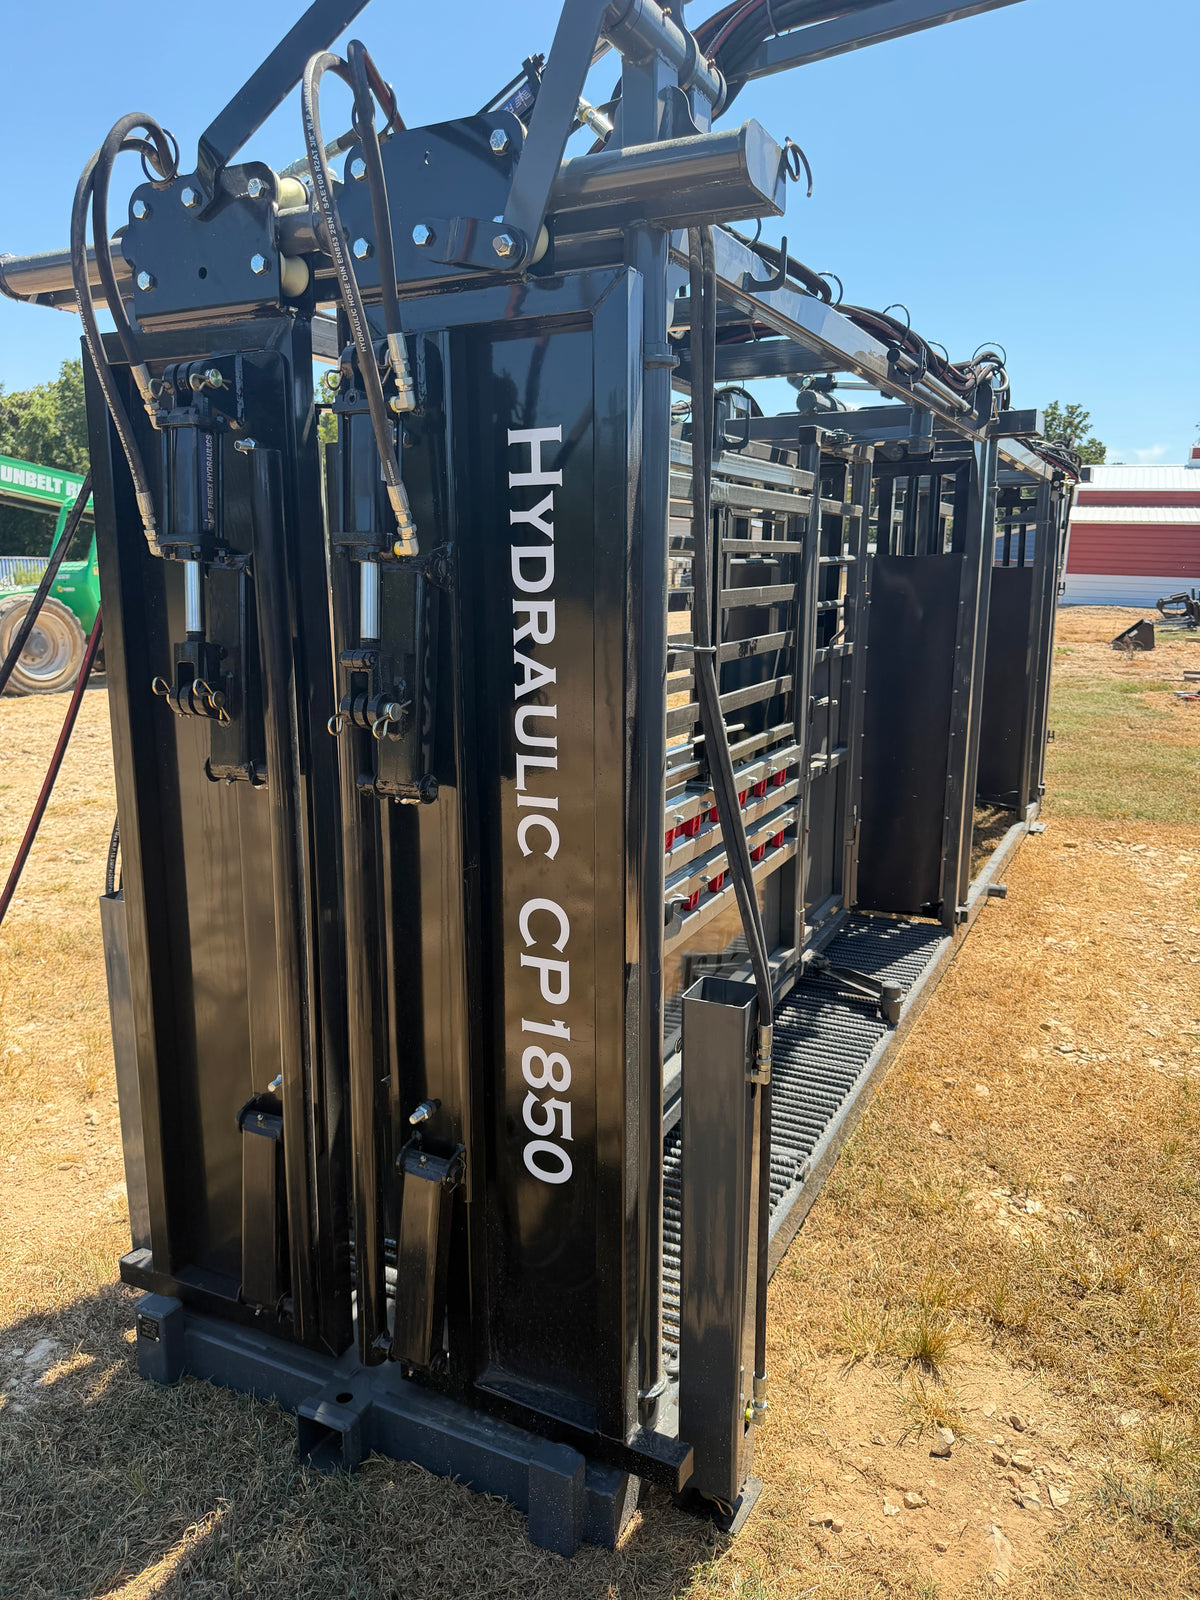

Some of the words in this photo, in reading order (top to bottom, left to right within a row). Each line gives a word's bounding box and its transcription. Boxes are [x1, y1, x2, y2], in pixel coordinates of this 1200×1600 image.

[311, 149, 321, 172] R2AT
[316, 173, 330, 209] SAE100
[326, 216, 337, 235] 2SN
[331, 236, 344, 264] EN853
[339, 266, 349, 281] DIN
[344, 282, 355, 306] HOSE
[351, 308, 367, 353] HYDRAULIC
[205, 434, 214, 482] HYDRAULICS
[207, 482, 215, 510] FENIEX
[507, 424, 563, 861] HYDRAULIC
[518, 897, 574, 1185] CP1850
